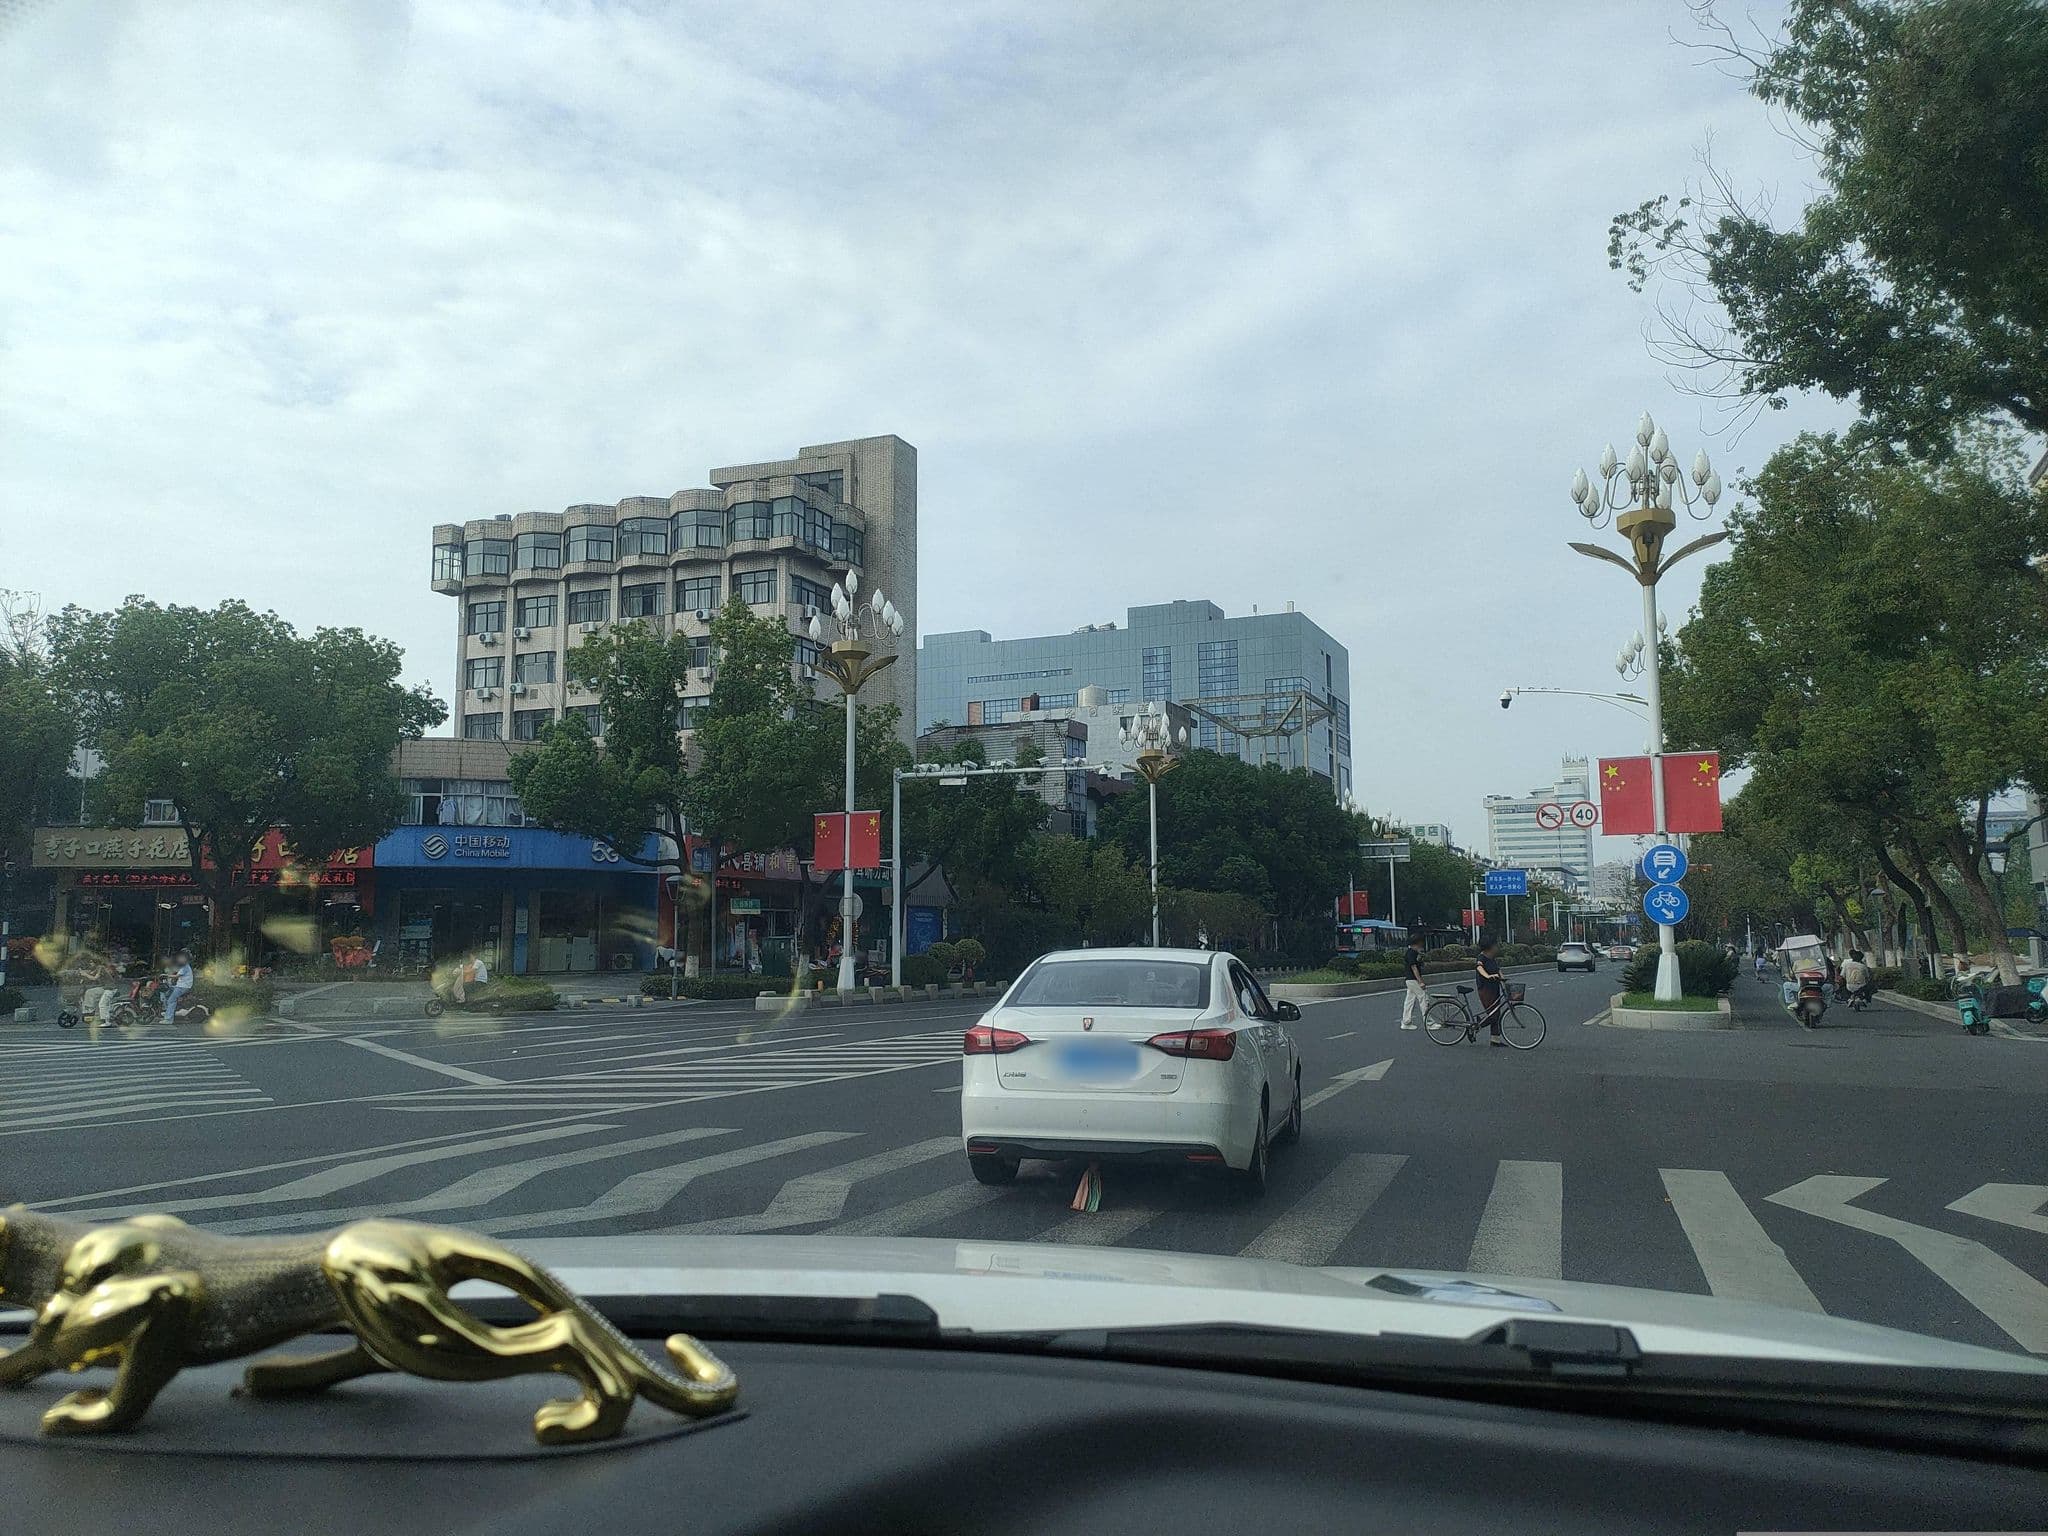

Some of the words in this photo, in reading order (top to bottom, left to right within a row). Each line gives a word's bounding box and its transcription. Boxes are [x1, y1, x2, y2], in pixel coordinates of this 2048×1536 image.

[1576, 809, 1593, 820] 40
[454, 835, 510, 848] 中国移动
[455, 848, 480, 858] China
[481, 849, 510, 859] Mobile
